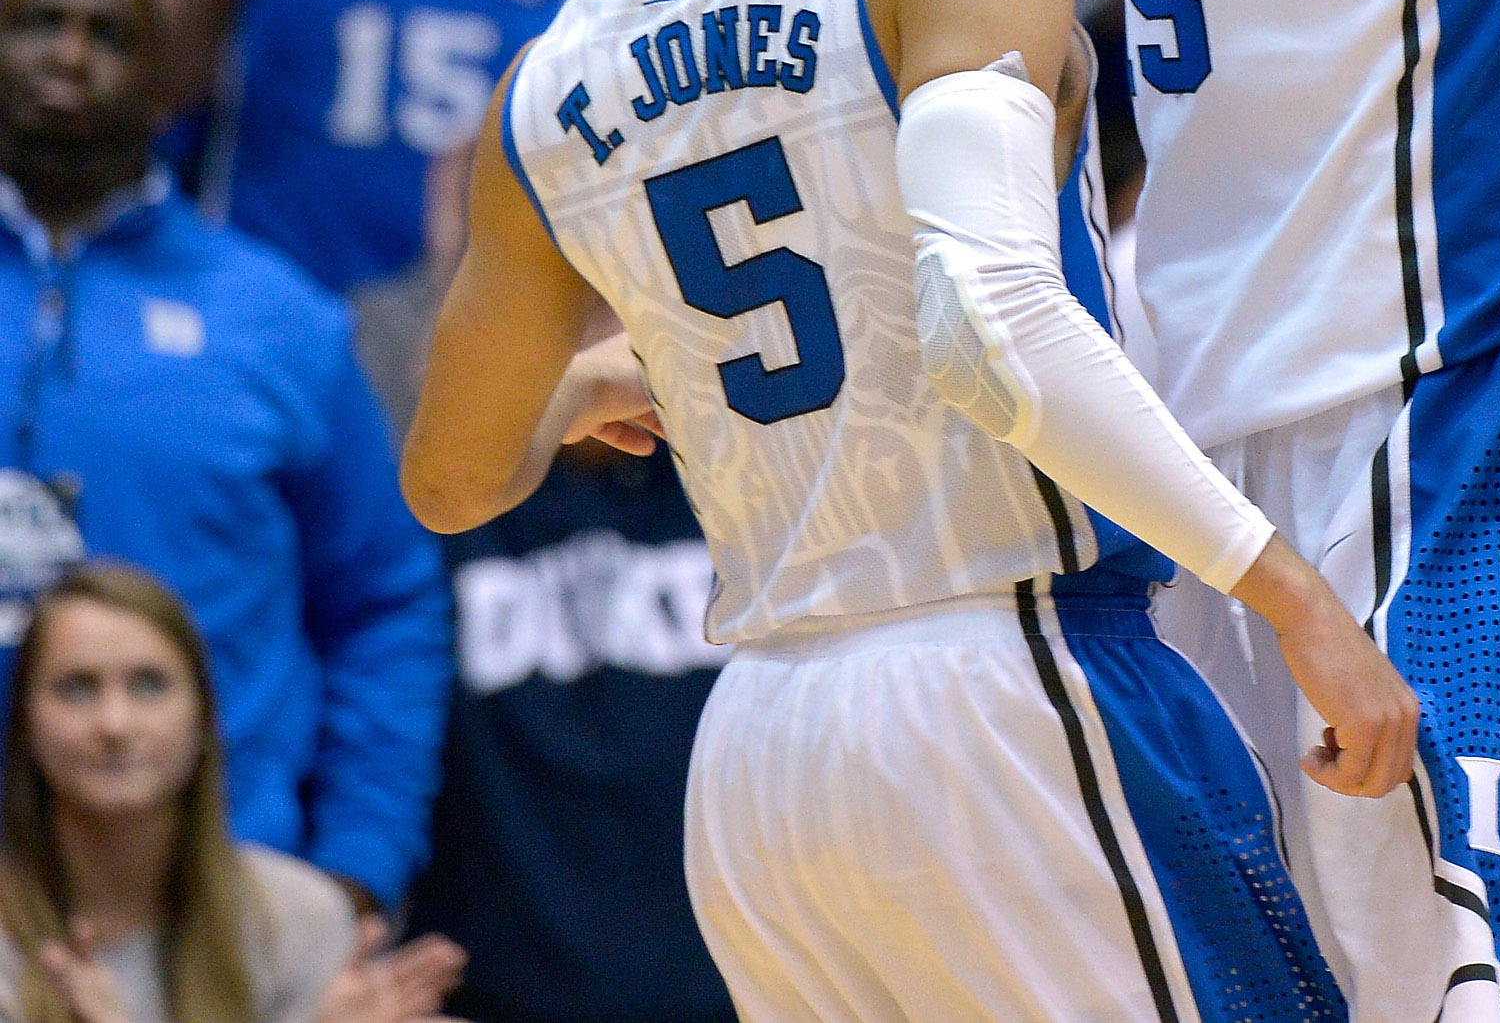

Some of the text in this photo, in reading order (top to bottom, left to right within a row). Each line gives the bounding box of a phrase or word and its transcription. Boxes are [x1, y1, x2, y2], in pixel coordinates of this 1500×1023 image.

[325, 1, 502, 157] 15
[557, 3, 821, 166] T. JONES
[643, 135, 845, 425] 5
